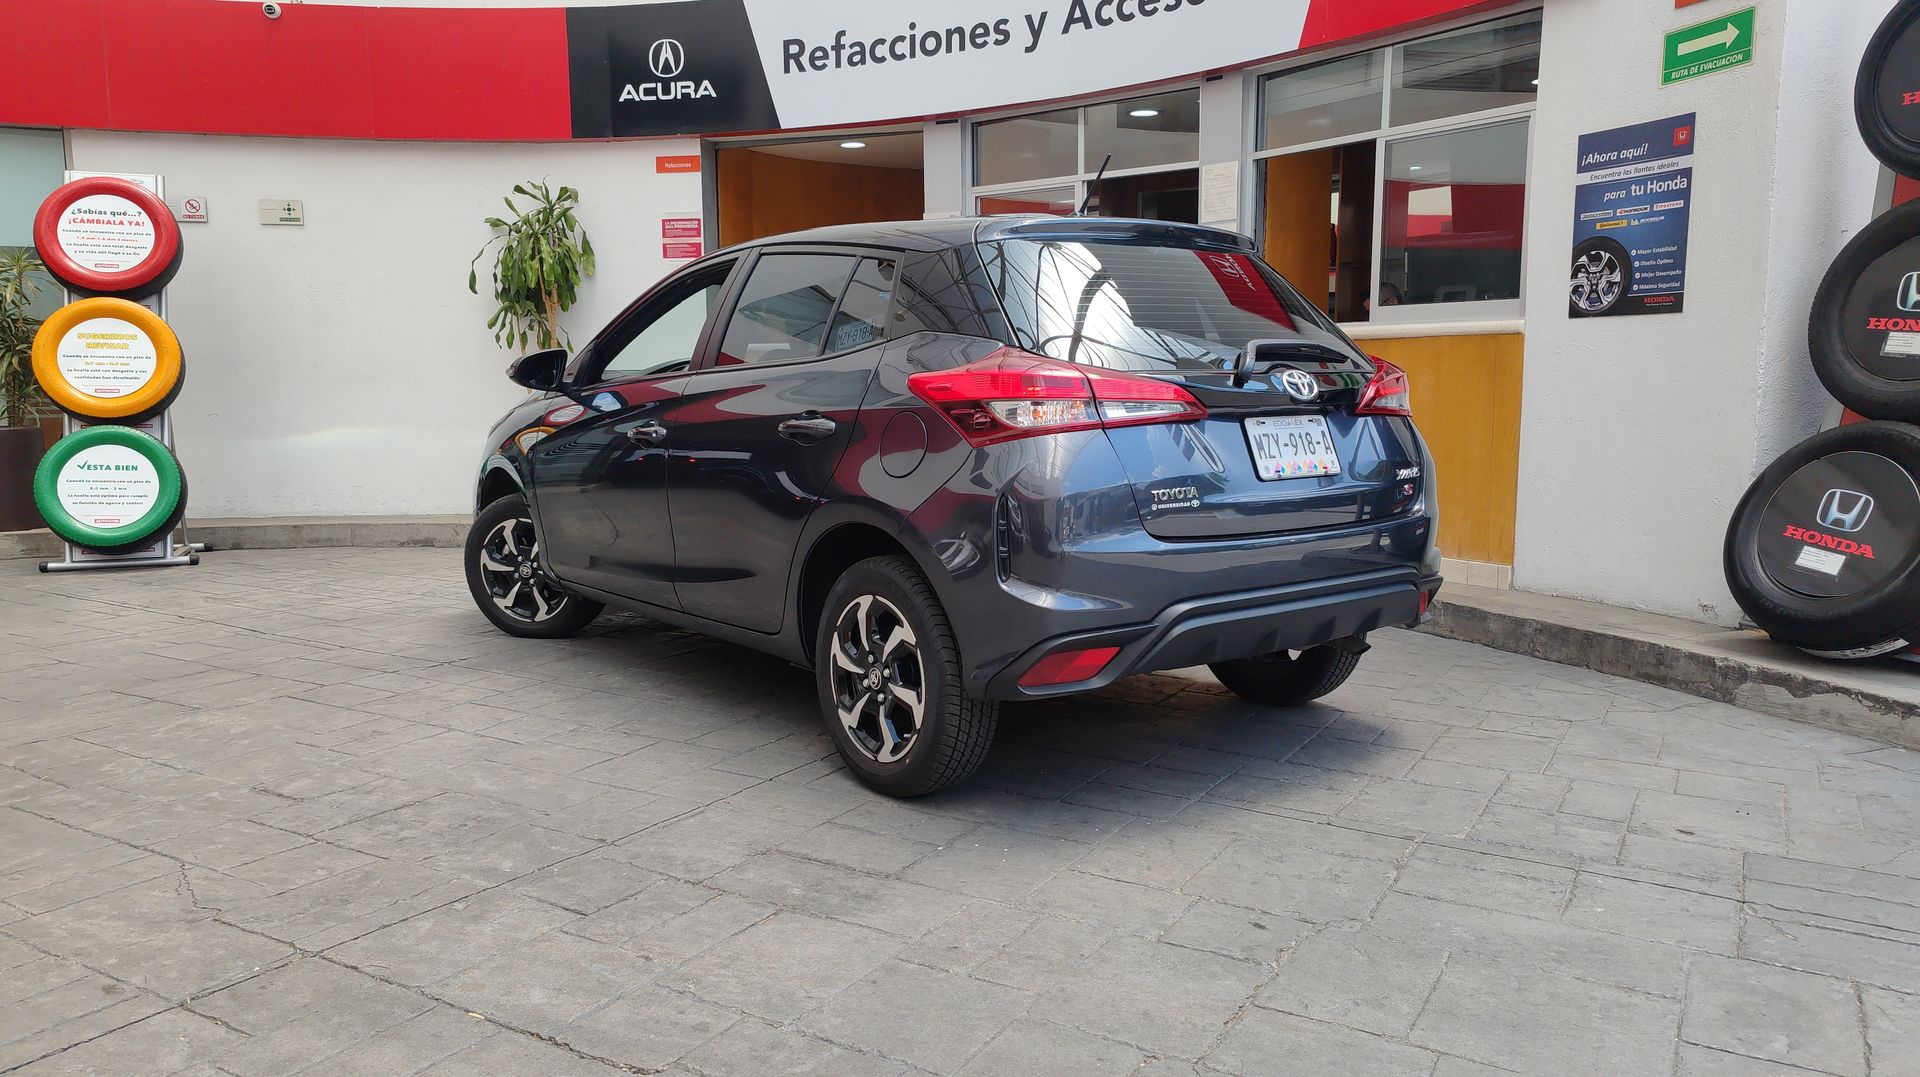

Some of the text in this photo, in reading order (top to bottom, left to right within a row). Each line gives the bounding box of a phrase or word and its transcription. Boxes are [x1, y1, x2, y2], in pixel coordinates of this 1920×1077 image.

[782, 16, 1011, 74] Refacciones
[1024, 9, 1048, 53] y
[1671, 69, 1688, 79] RUTA
[619, 80, 717, 102] ACURA
[1582, 143, 1648, 166] ¡Ahora aquí!
[1590, 170, 1622, 181] Encuentra
[1633, 165, 1655, 174] llantas
[1656, 160, 1680, 170] ideales
[1604, 175, 1687, 202] para tu Honda
[68, 217, 125, 226] ¡CÁMBIALA
[71, 207, 107, 215] ¿Sabías
[1253, 430, 1332, 460] MZY-918-A
[1151, 486, 1199, 501] TOYOTA
[1783, 525, 1875, 559] HONDA
